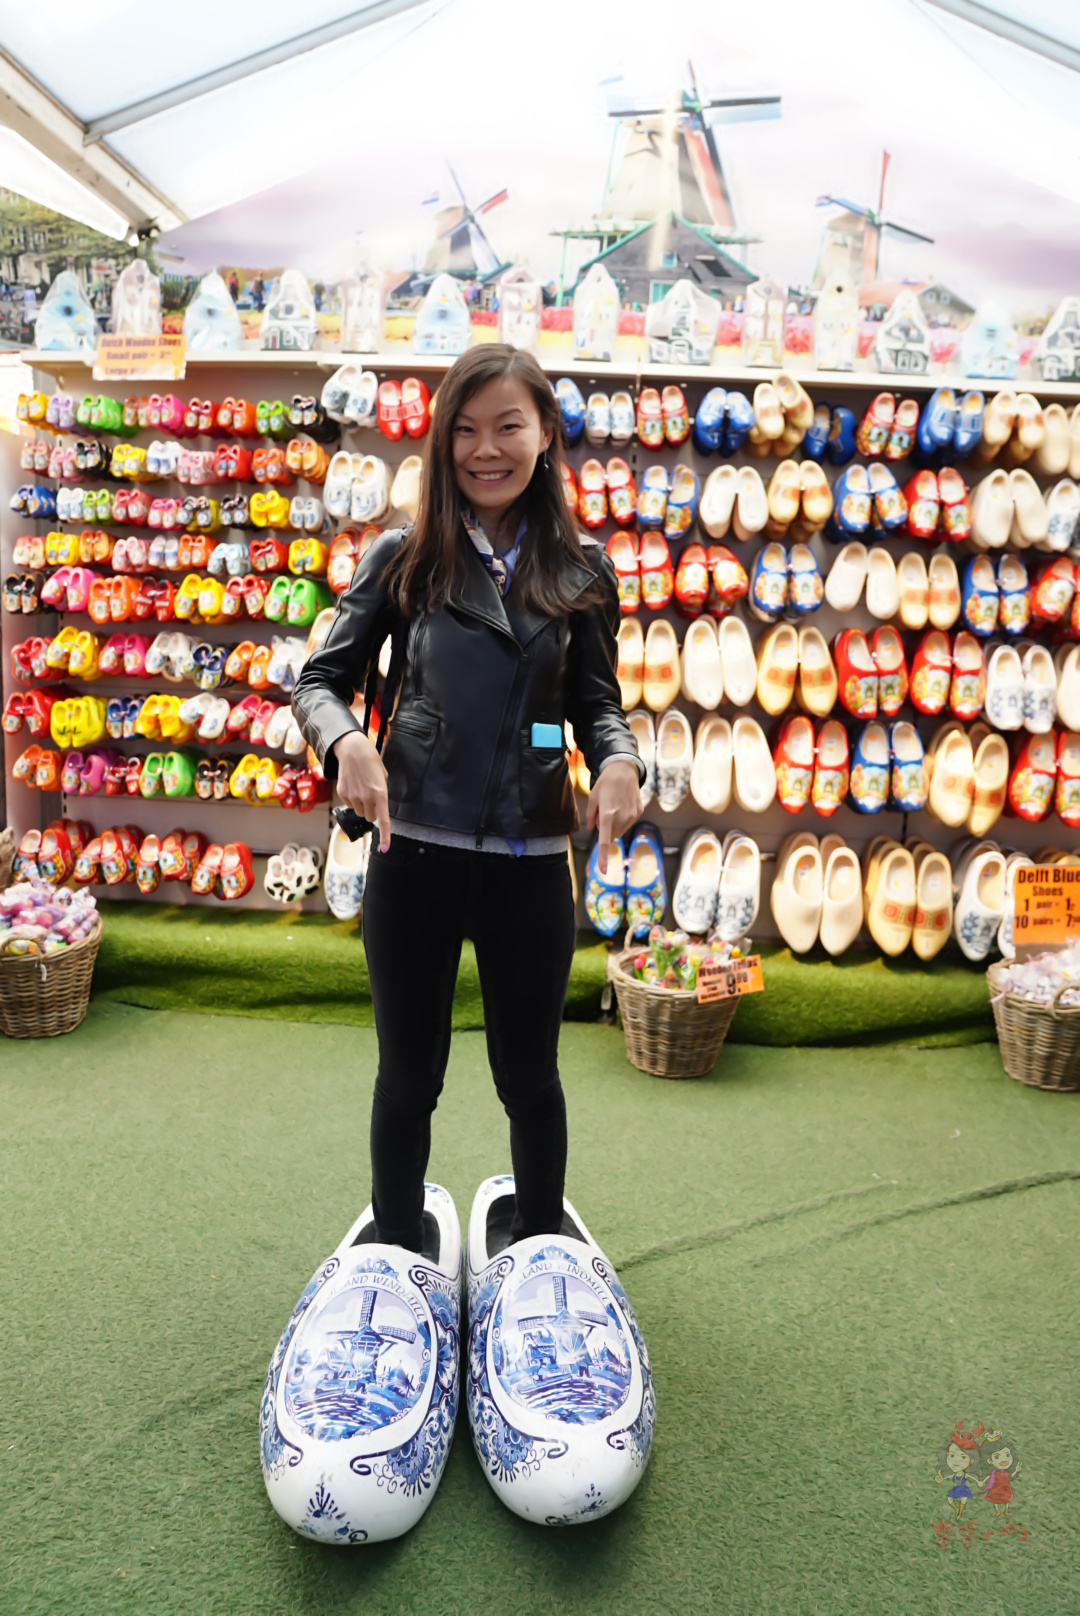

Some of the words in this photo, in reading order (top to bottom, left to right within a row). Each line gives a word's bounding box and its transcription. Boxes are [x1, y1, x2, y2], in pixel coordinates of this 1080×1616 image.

[125, 338, 156, 347] Wooden
[158, 337, 182, 347] Shoes
[1018, 868, 1049, 884] Delft
[1032, 886, 1063, 897] Shoes
[1024, 898, 1029, 912] 1
[1036, 901, 1053, 910] pair
[1015, 914, 1029, 929] 10
[699, 964, 732, 978] Wooden
[373, 1273, 426, 1320] WINDMILL
